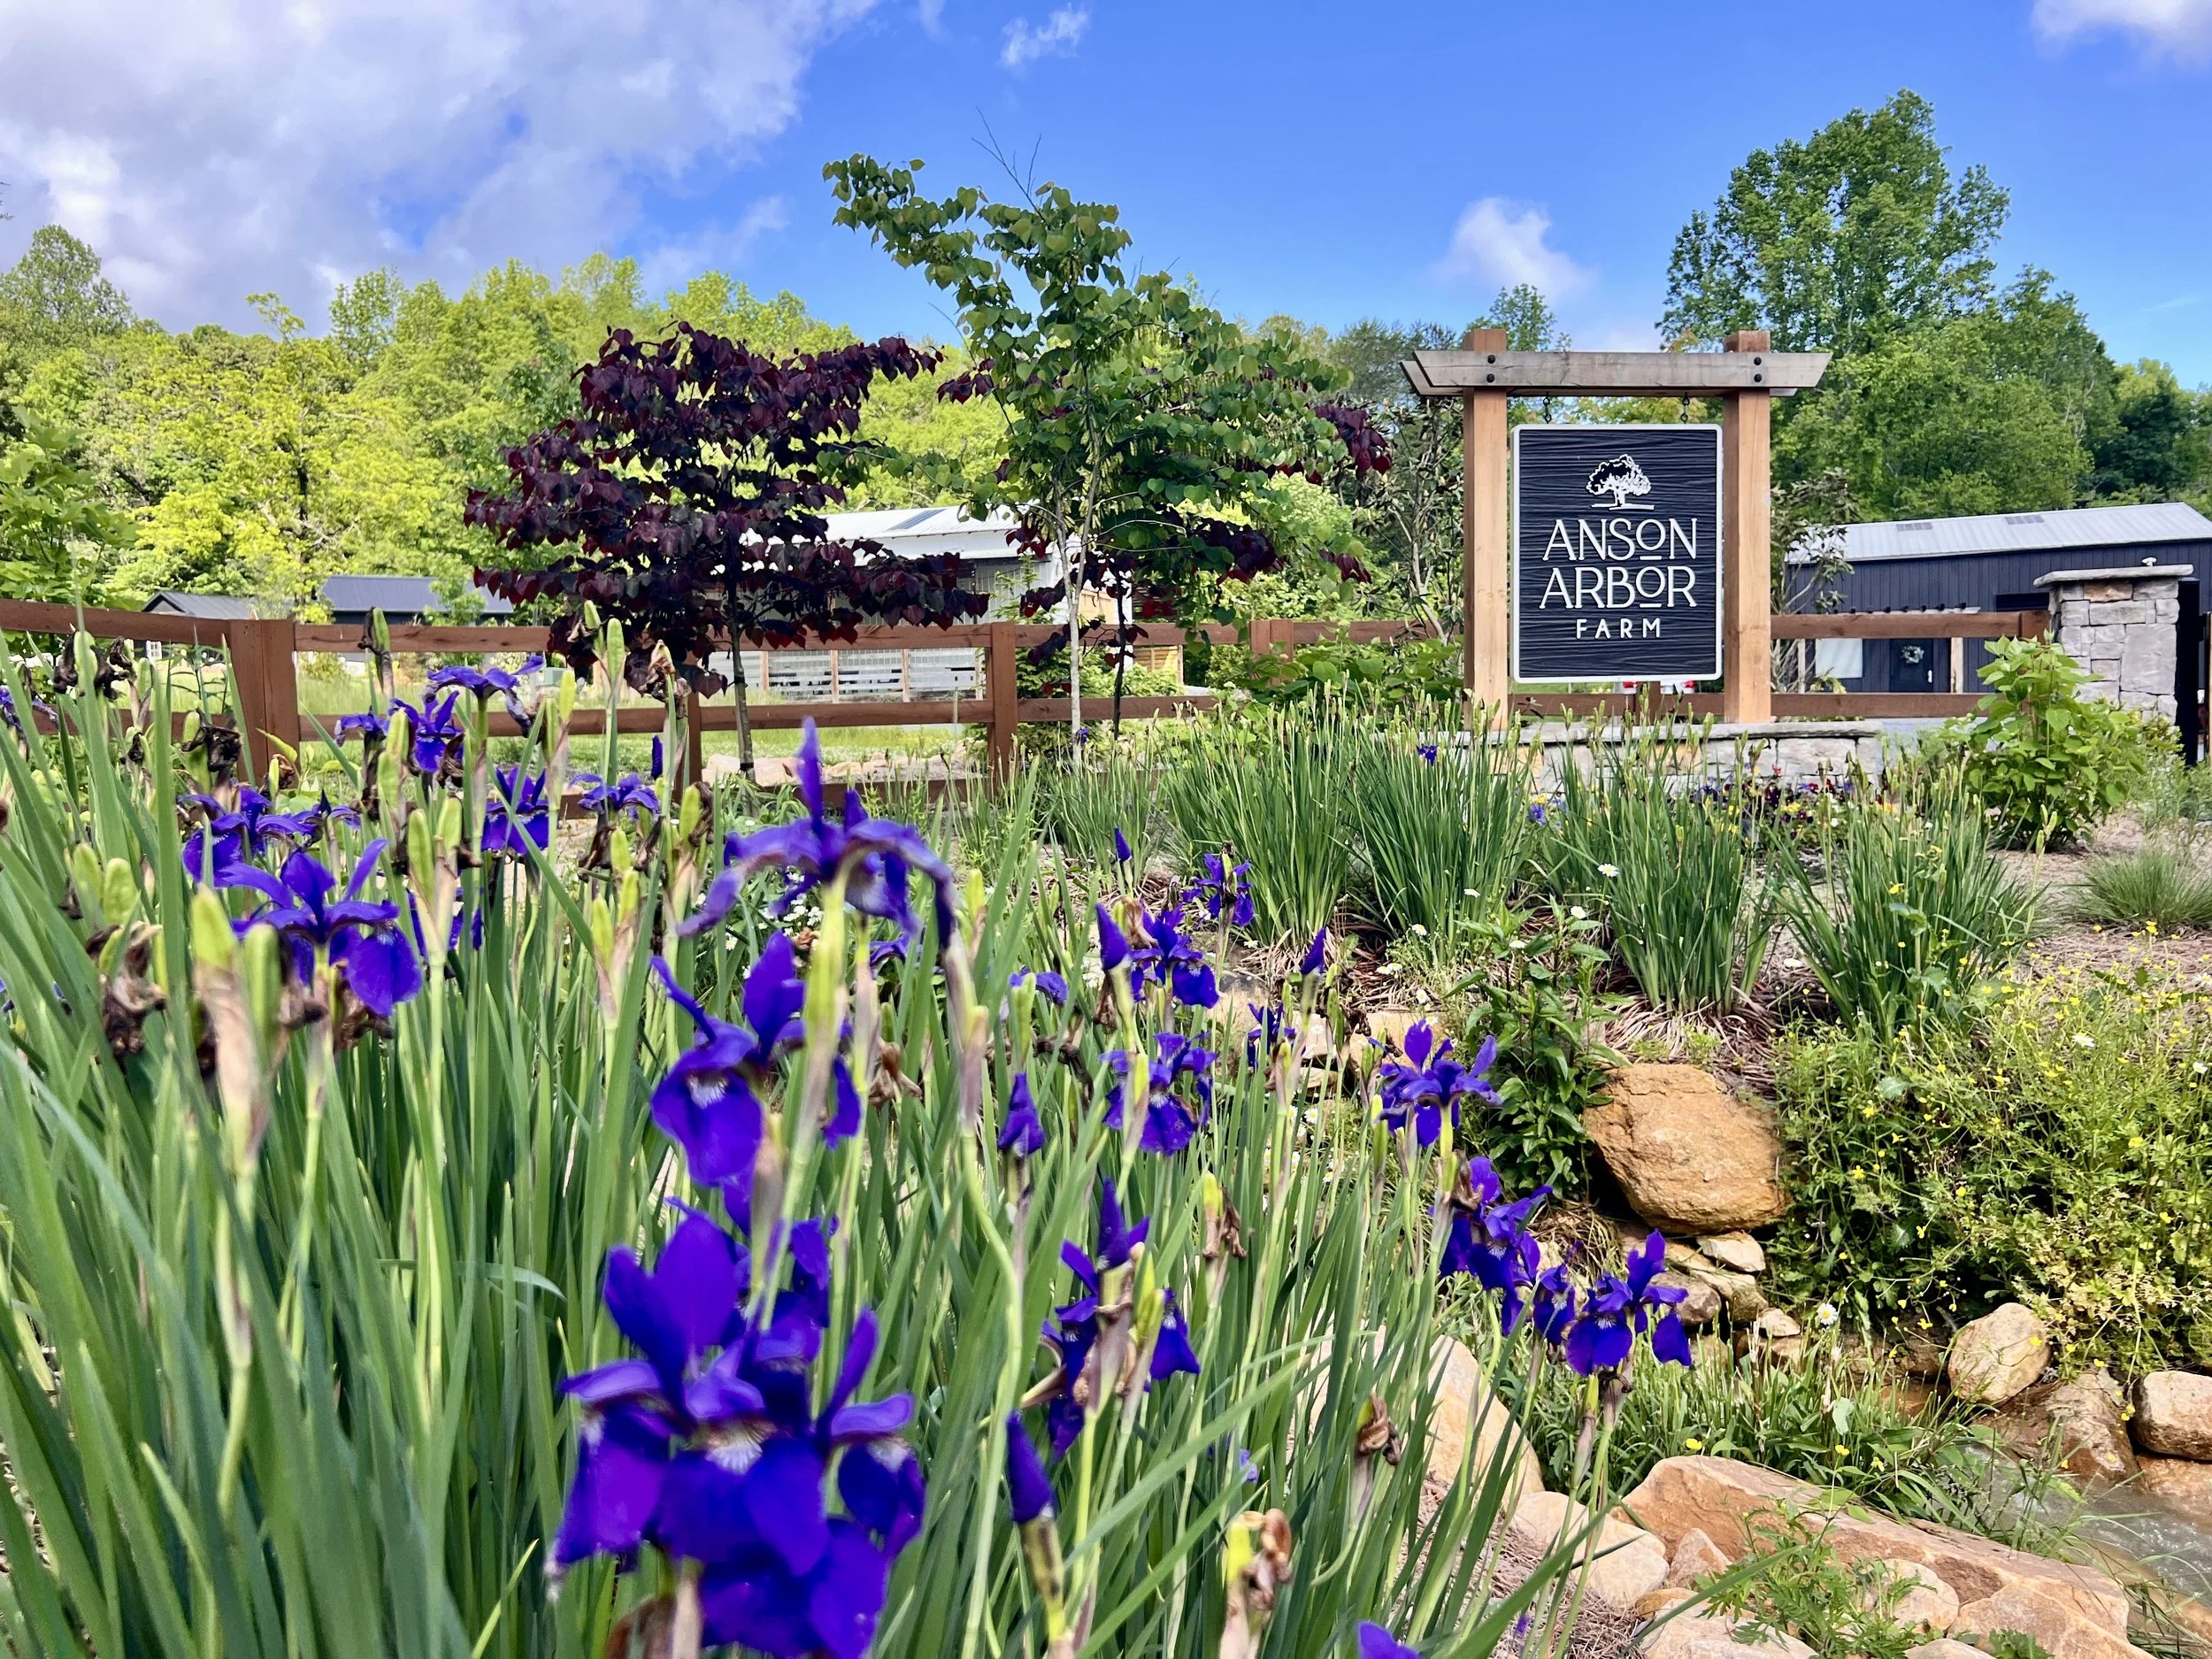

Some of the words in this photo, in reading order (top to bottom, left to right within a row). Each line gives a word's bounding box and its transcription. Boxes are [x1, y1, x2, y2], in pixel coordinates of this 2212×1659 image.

[1542, 518, 1697, 561] ANSON
[1539, 565, 1697, 609] ARBOR
[1576, 618, 1661, 639] FARM
